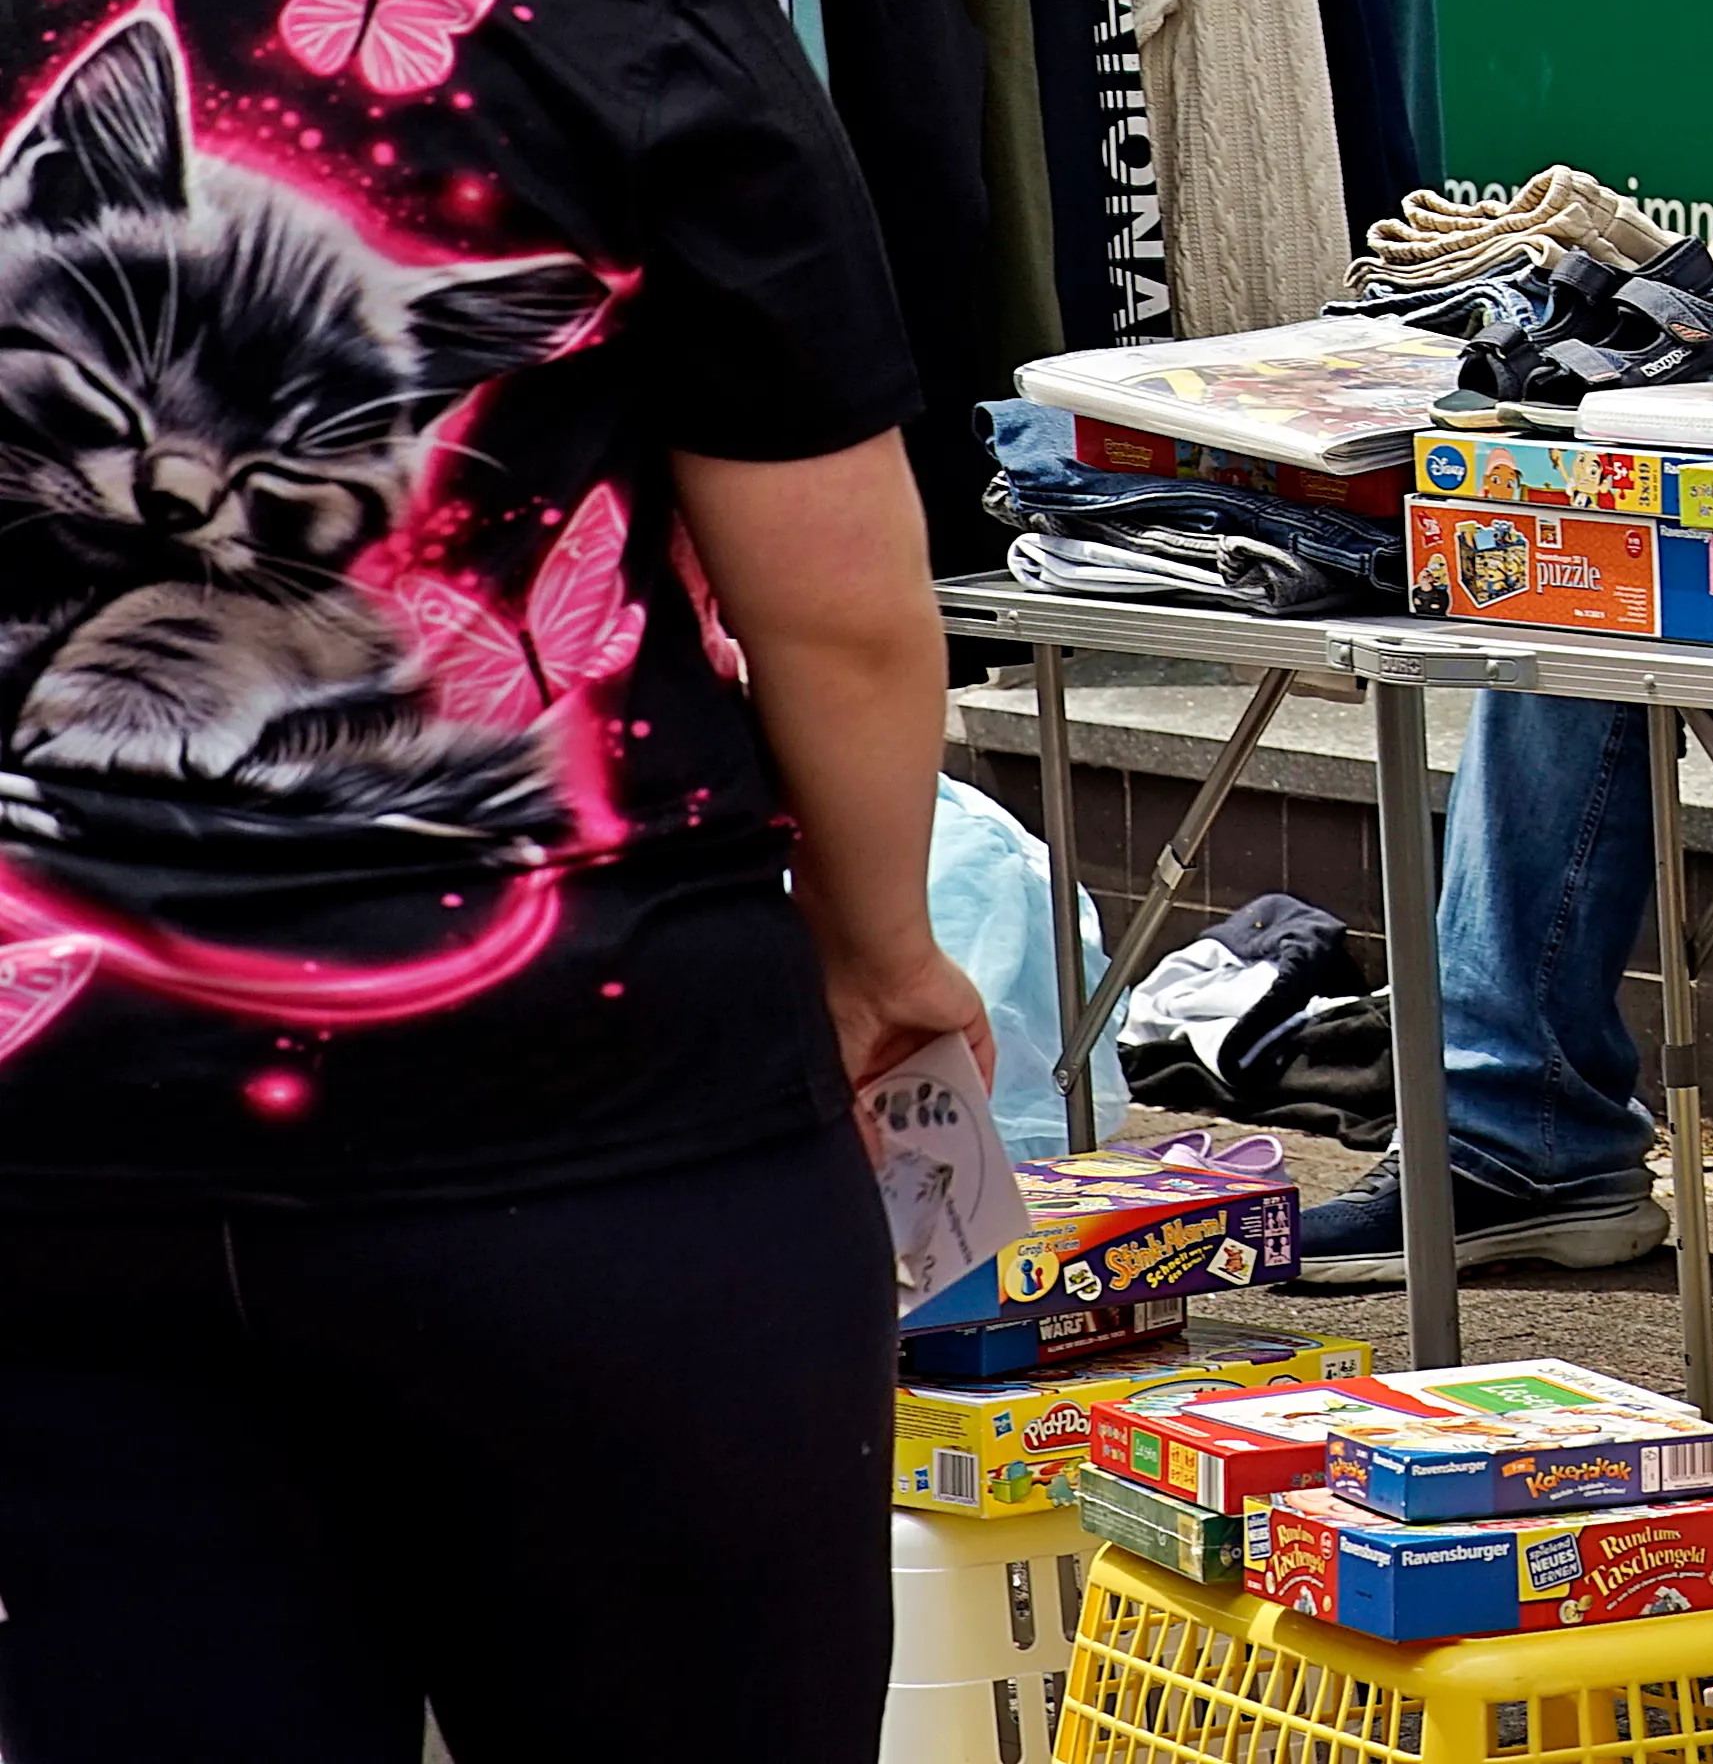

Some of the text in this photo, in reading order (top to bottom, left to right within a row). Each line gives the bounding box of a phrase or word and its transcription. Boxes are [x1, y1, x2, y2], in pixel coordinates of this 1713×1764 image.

[1535, 558, 1601, 594] puzzle
[1039, 1316, 1084, 1341] WARS
[1411, 1461, 1488, 1477] Ravensburger
[1525, 1457, 1632, 1499] Kakerlakak
[1340, 1536, 1392, 1567] Ravensburger
[1402, 1543, 1511, 1567] Ravensburger
[1528, 1536, 1572, 1562] spielend
[1600, 1527, 1682, 1561] Rund ums
[1530, 1548, 1577, 1574] NEUES
[1584, 1545, 1706, 1599] Taschengeld
[1533, 1563, 1579, 1588] LERNEN
